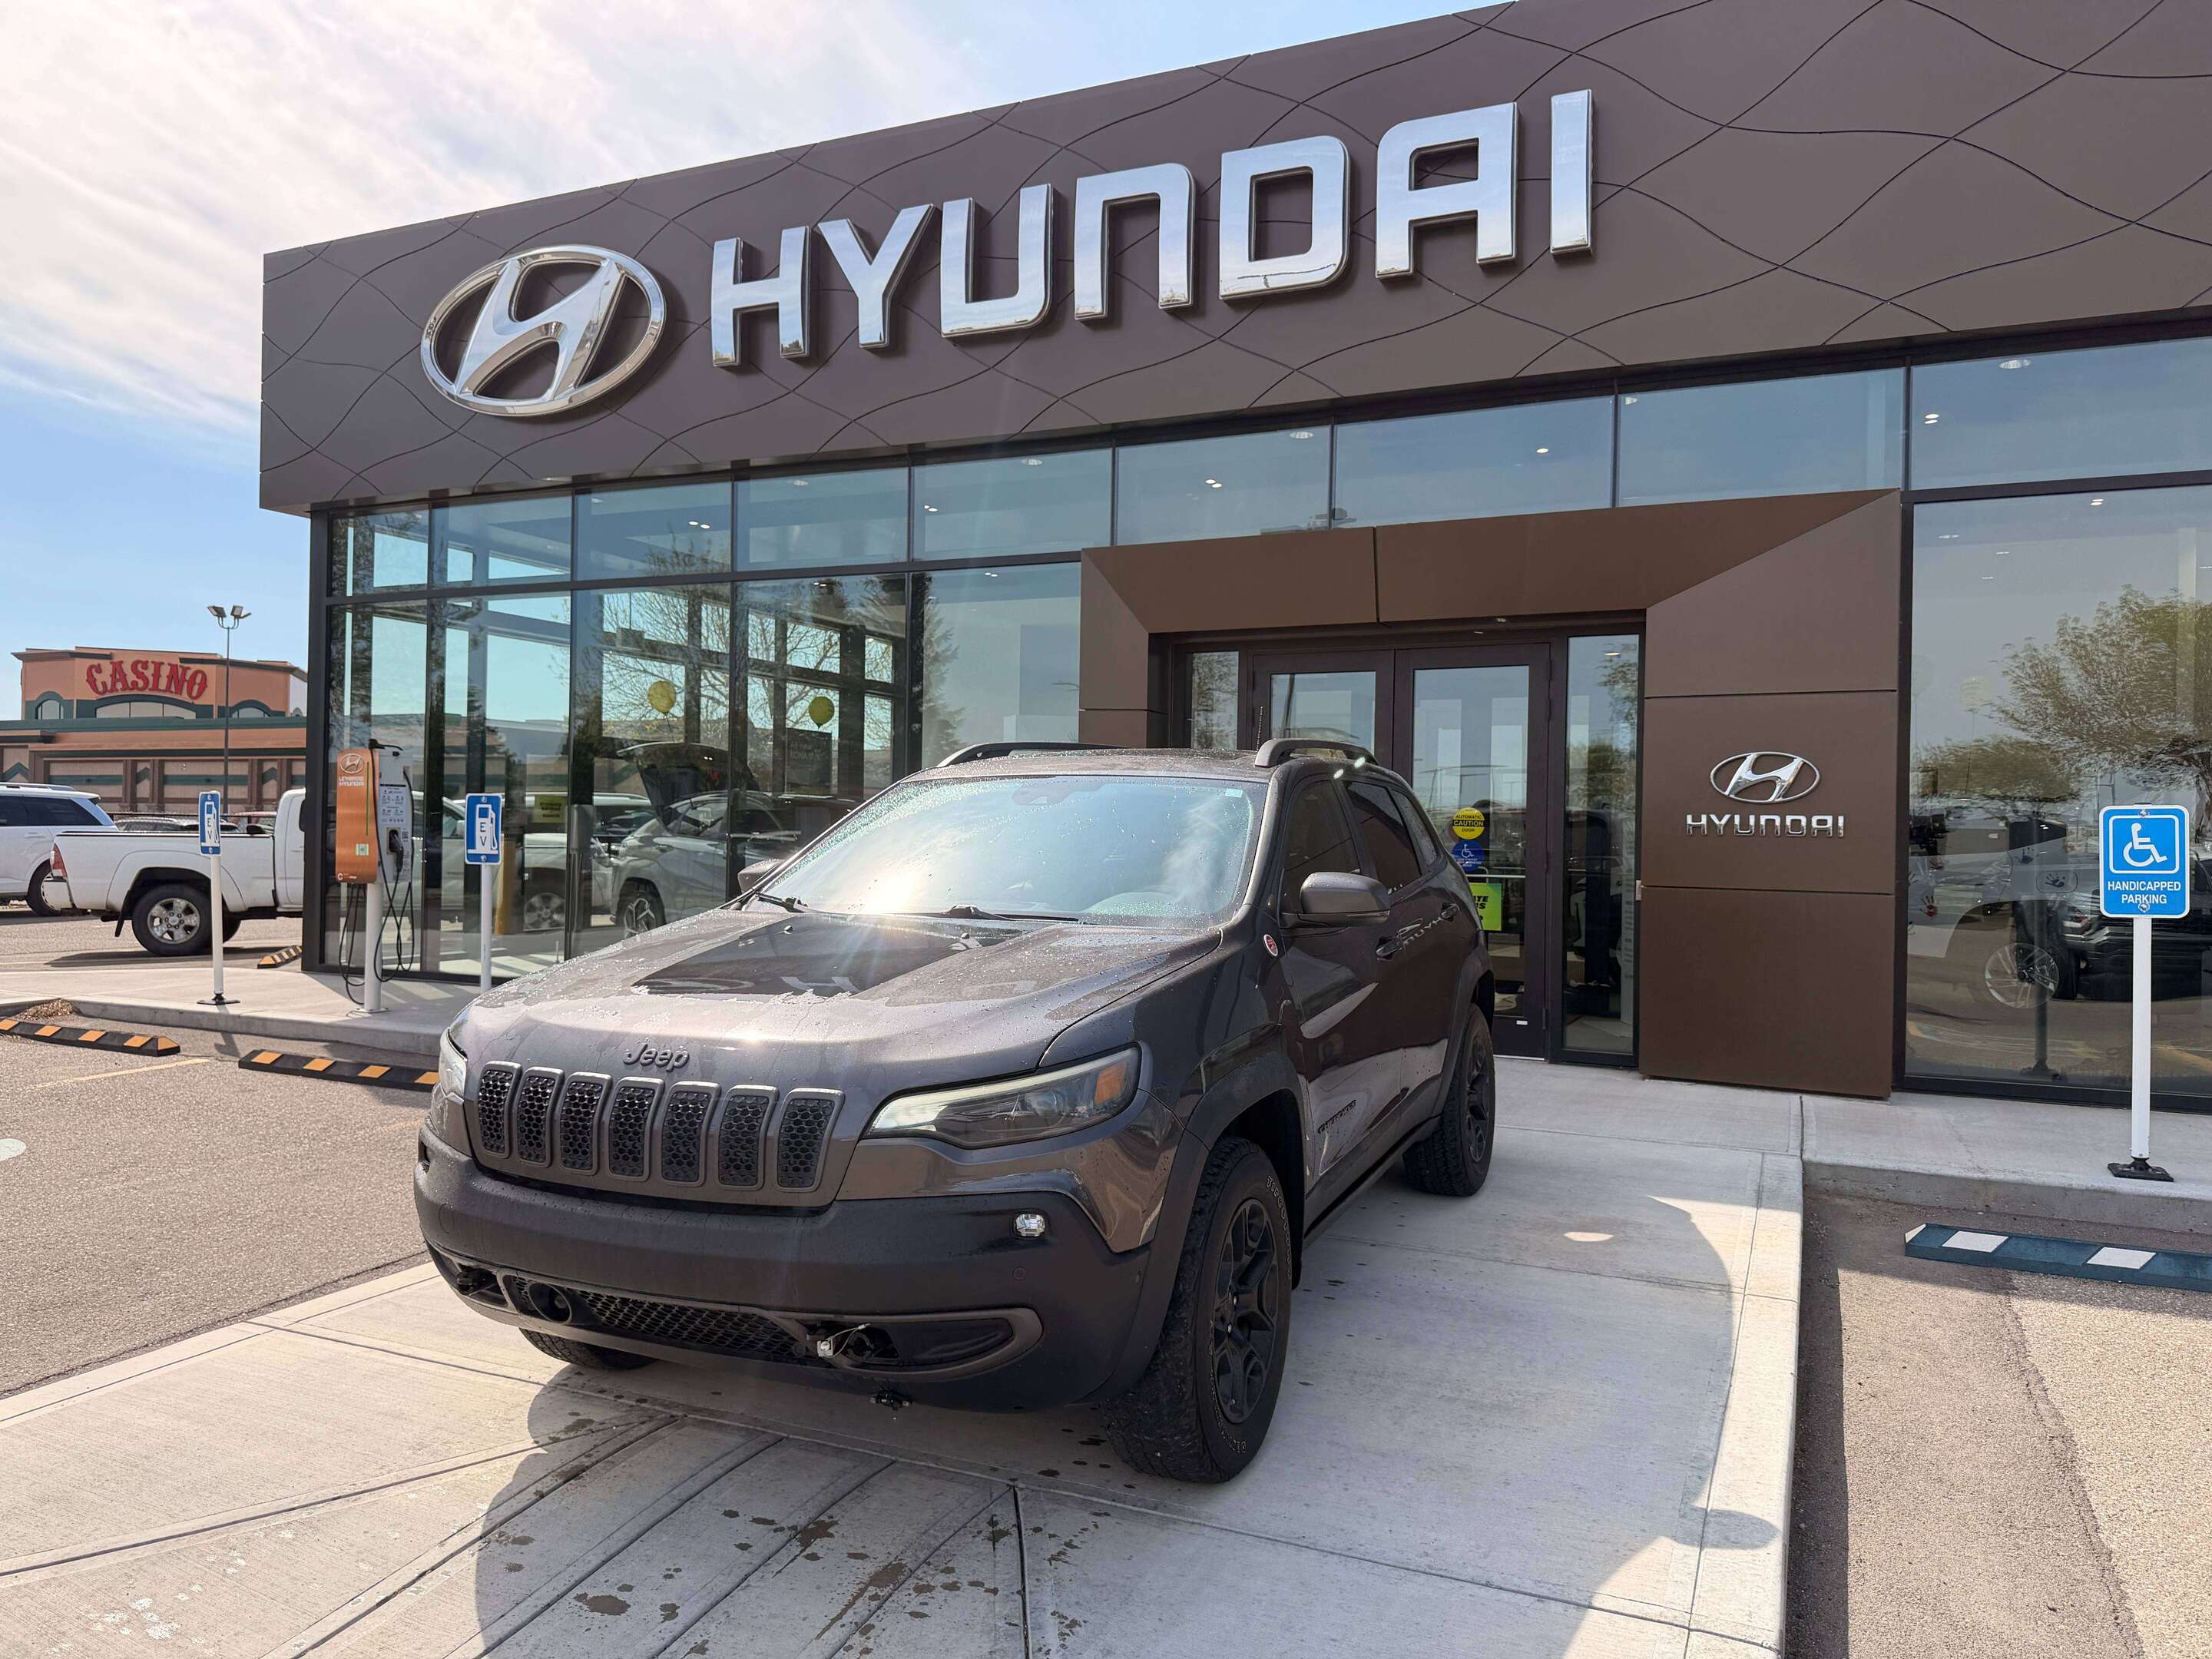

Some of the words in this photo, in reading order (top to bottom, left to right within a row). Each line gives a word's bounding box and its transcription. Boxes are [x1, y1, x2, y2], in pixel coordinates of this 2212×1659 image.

[710, 88, 1594, 367] HYUNDAI
[86, 659, 208, 700] CASINO
[1686, 814, 1844, 838] HYUNDAI
[2107, 880, 2182, 892] HANDICAPPED
[2121, 893, 2167, 904] PARKING
[623, 1043, 690, 1072] Jeep
